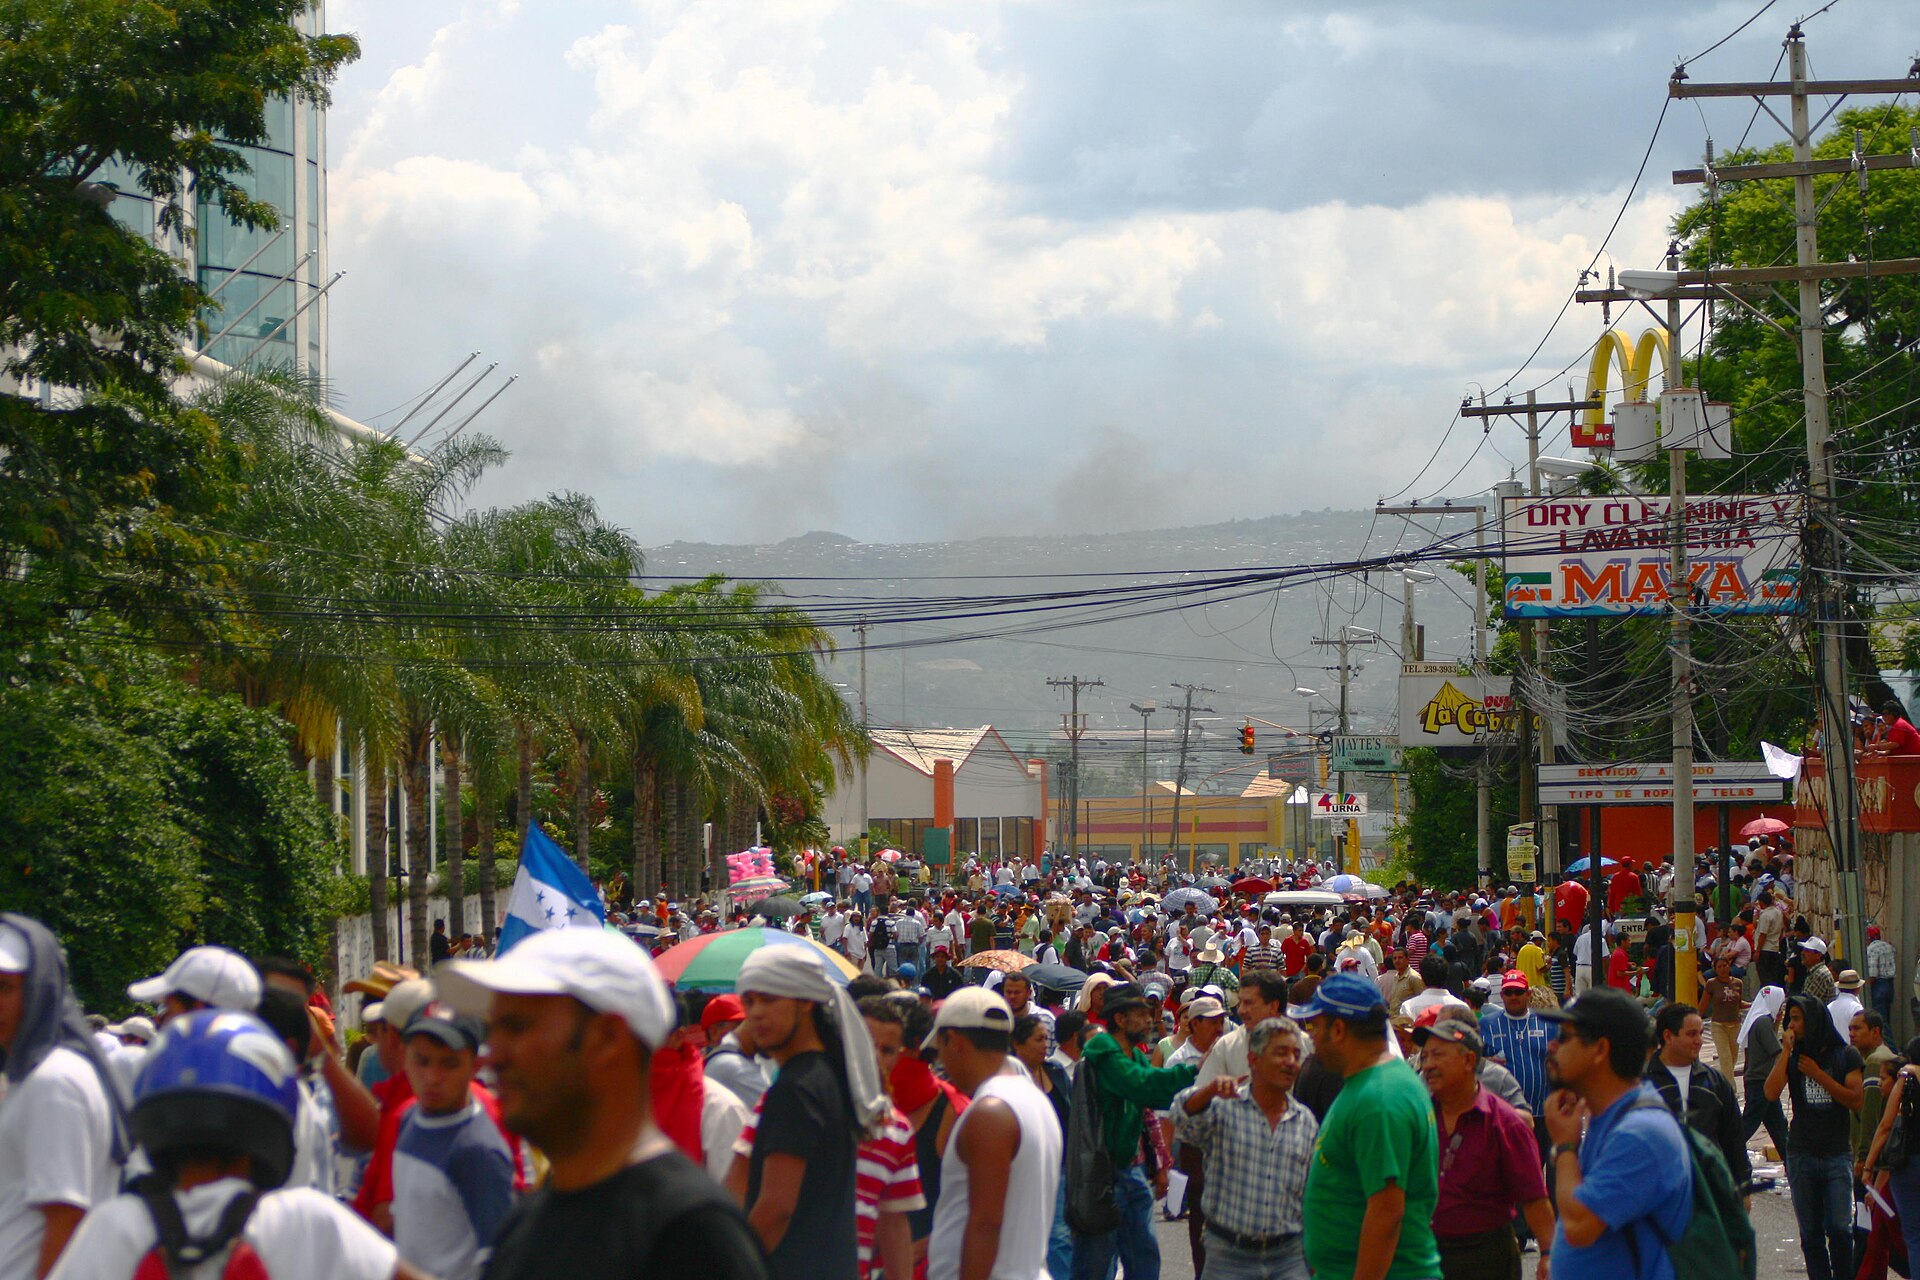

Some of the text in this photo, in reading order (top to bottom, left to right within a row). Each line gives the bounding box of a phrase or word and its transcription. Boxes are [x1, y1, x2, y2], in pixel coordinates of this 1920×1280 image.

[1528, 504, 1592, 526] DRY
[1772, 501, 1790, 523] Y
[1558, 557, 1752, 605] MAYA
[1403, 664, 1457, 674] TEL. 239-3933
[1423, 700, 1545, 736] La Cabaa
[1335, 737, 1381, 757] MAYTE'S
[1578, 766, 1714, 777] SERVICIO A ODO
[1568, 790, 1603, 799] TIPO
[1615, 789, 1632, 798] DE
[1644, 788, 1674, 798] ROP
[1712, 787, 1755, 797] TELAS
[1332, 805, 1361, 813] URNA
